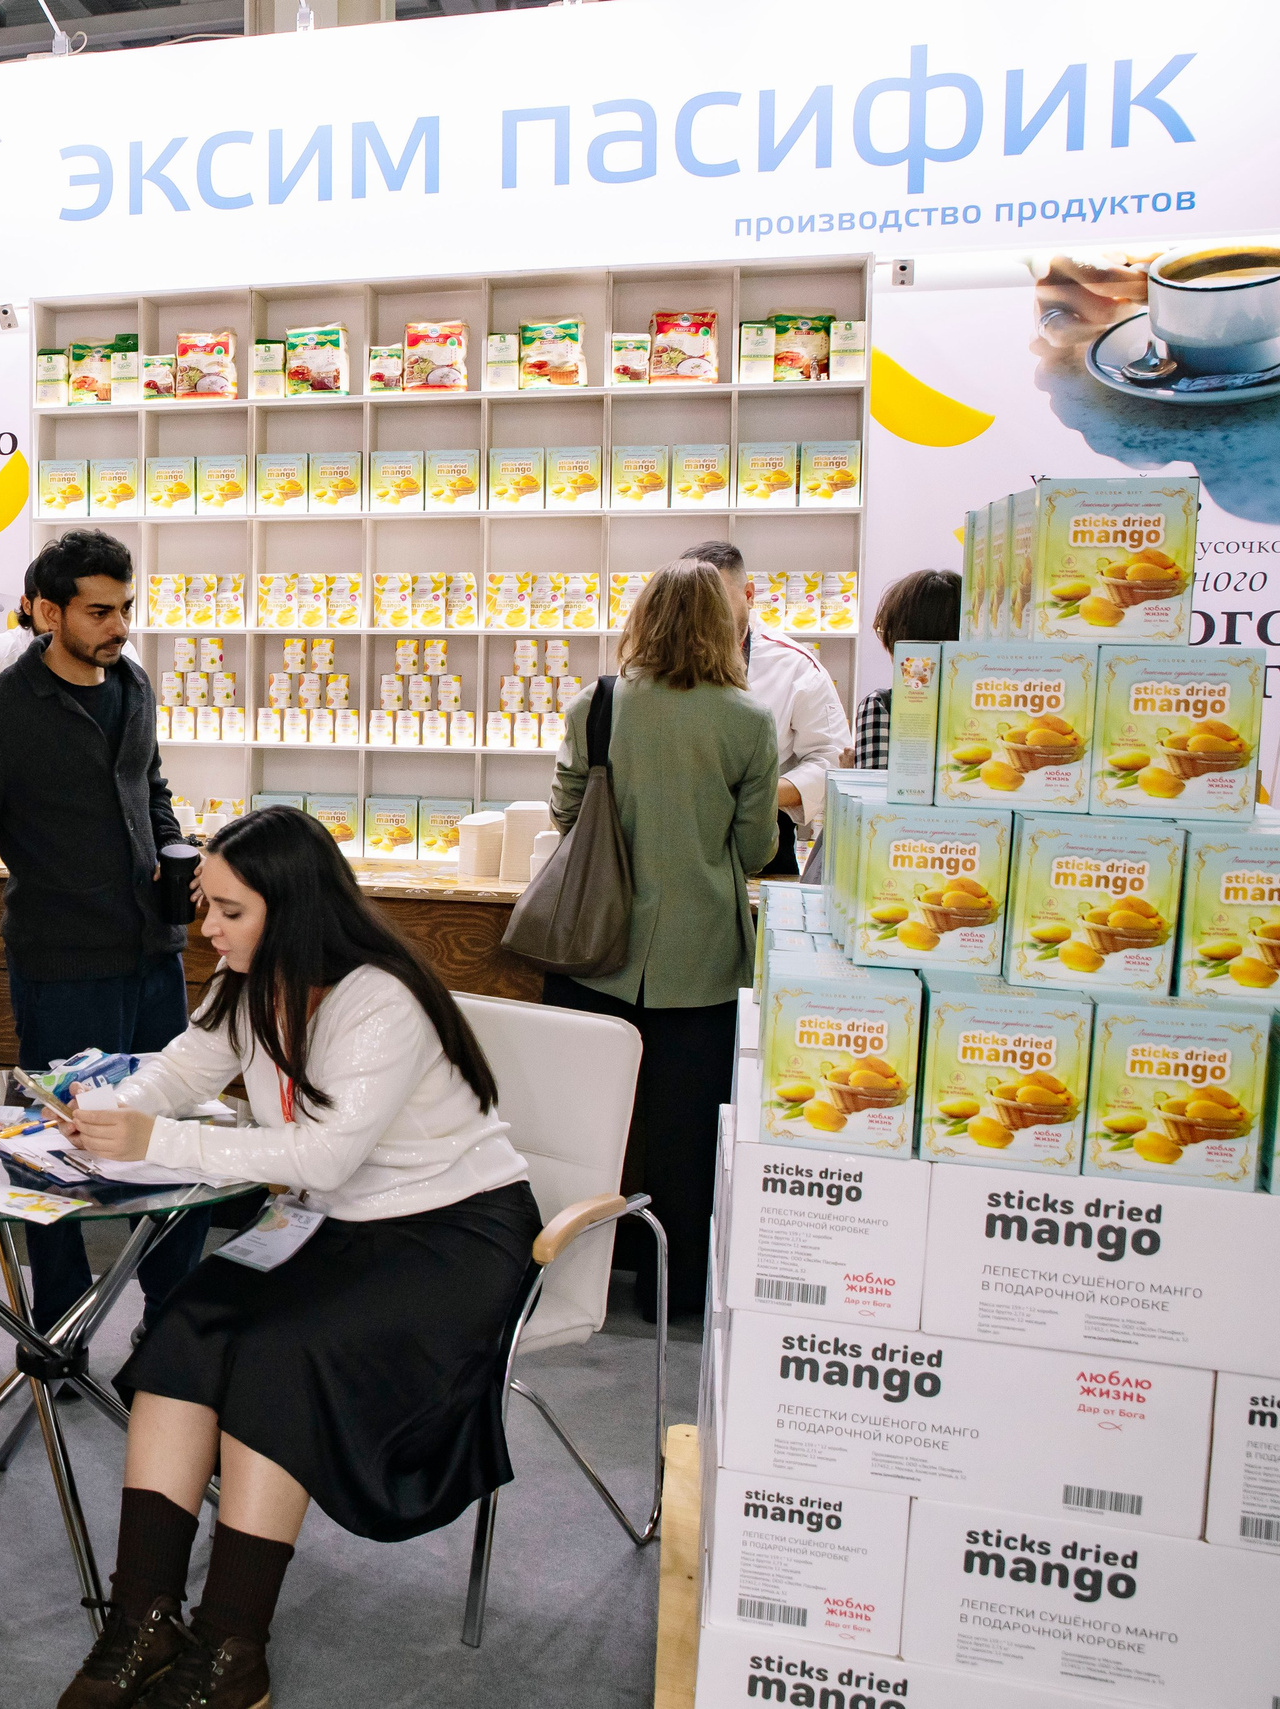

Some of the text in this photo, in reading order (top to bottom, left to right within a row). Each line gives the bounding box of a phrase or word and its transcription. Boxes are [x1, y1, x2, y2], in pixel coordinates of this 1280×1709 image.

[59, 43, 1198, 222] эксим пасифик
[734, 190, 1197, 241] производство продуктов
[437, 467, 467, 475] mango
[624, 464, 656, 472] mango
[813, 460, 847, 469] mango
[1073, 517, 1161, 528] sticks dried
[1072, 529, 1161, 548] mango
[1194, 540, 1280, 560] усочко
[975, 681, 1061, 693] sticks dried
[1134, 685, 1226, 697] sticks dried
[975, 693, 1061, 713] mango
[1133, 697, 1226, 718] mango
[893, 842, 976, 856] sticks dried
[892, 854, 975, 876] mango
[1056, 859, 1145, 875] sticks dried
[1054, 871, 1144, 895] mango
[800, 1018, 884, 1034] sticks dried
[798, 1030, 884, 1054] mango
[763, 1163, 863, 1183] sticks dried
[762, 1177, 863, 1205] mango
[760, 1207, 889, 1227] ЛЕПЕСТКИ СУШЁНОГО МАНГО
[987, 1190, 1162, 1224] sticks dried
[767, 1217, 827, 1231] ПОДАРОЧНОЙ
[829, 1224, 870, 1235] КОРОБКЕ
[985, 1212, 1162, 1262] mango
[843, 1272, 896, 1287] люблю
[846, 1283, 892, 1296] жизнь
[981, 1264, 1203, 1299] ЛЕПЕСТКИ СУШЁНОГО МАНГО
[844, 1297, 861, 1306] Дар
[872, 1300, 892, 1308] Бога
[981, 1281, 1170, 1312] В ПОДАРОЧНОЙ КОРОБКЕ
[782, 1334, 943, 1368] sticks dried
[780, 1354, 942, 1403] mango
[1076, 1370, 1152, 1390] люблю
[1079, 1385, 1146, 1403] жизнь
[745, 1489, 842, 1512] sticks dried
[744, 1502, 842, 1532] mango
[966, 1529, 1138, 1569] sticks dried
[963, 1548, 1137, 1603] mango
